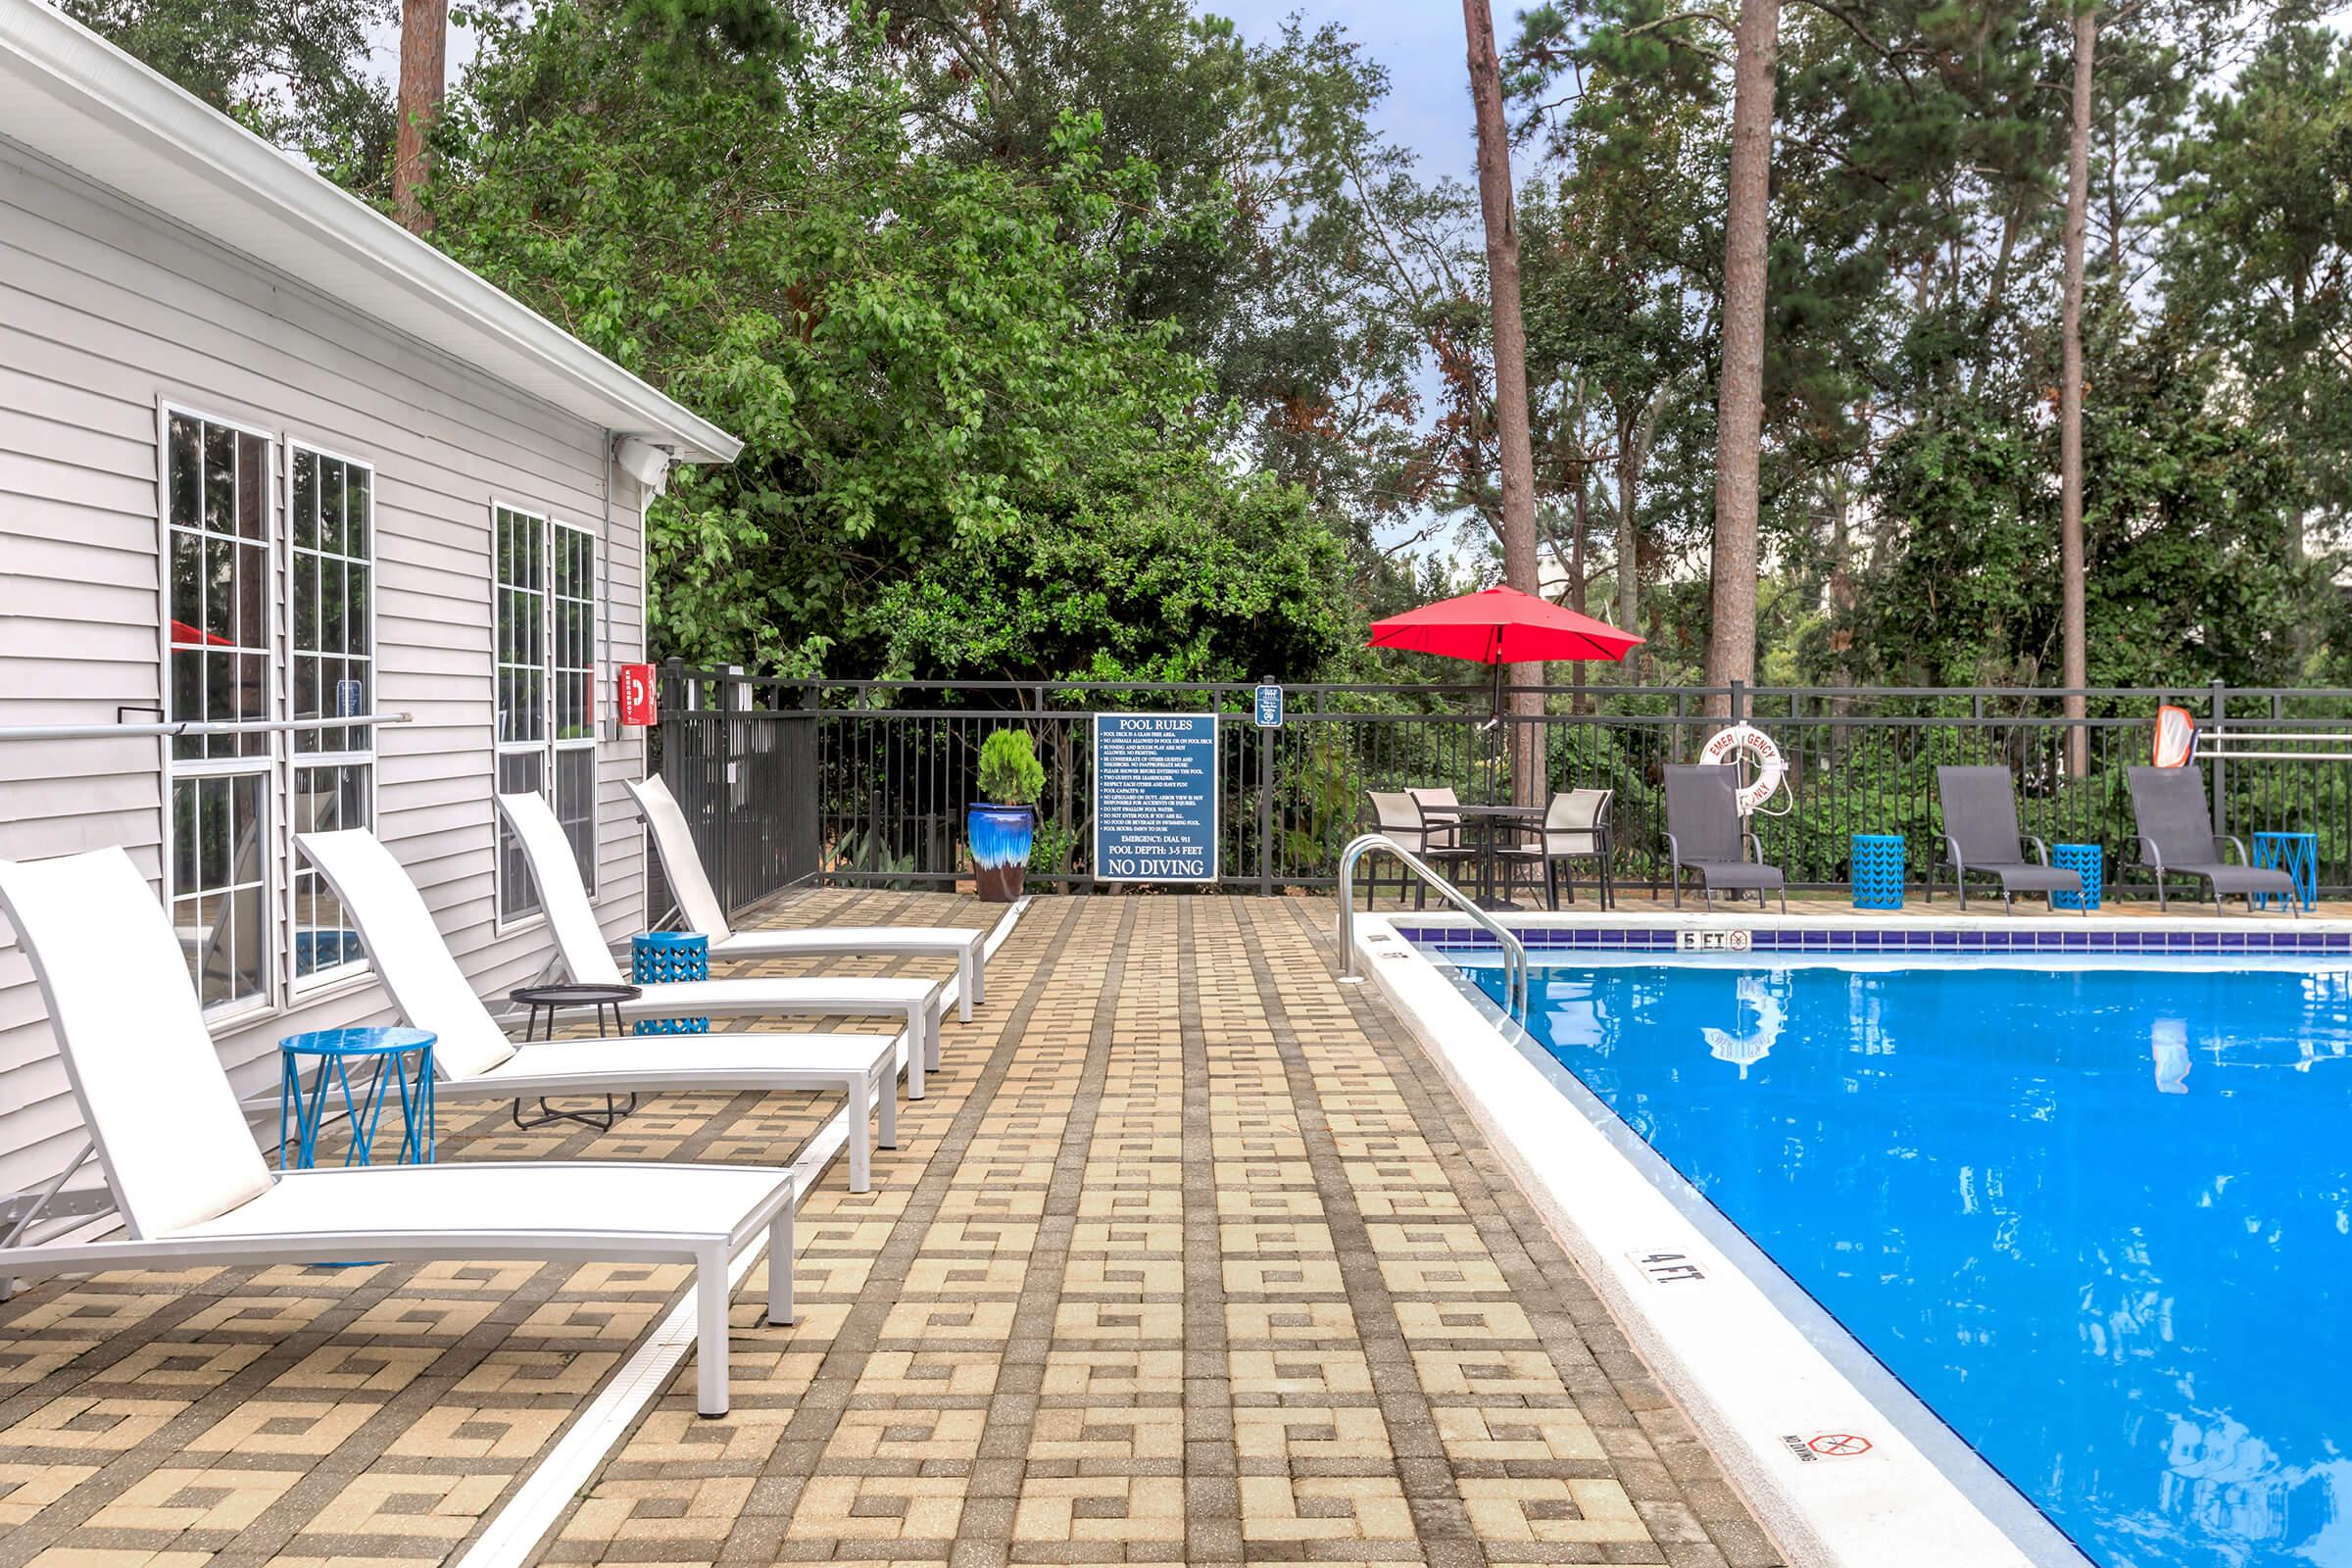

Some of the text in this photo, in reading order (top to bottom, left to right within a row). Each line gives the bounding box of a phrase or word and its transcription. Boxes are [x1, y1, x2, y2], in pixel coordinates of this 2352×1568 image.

[1120, 720, 1192, 730] POOL RULES
[1709, 733, 1775, 758] EMER GENCY
[1109, 846, 1203, 855] POOL DEPTH: 3-5 FEET
[1108, 860, 1204, 875] NO DIVING
[1684, 933, 1724, 949] 5 FT
[1641, 1254, 1686, 1264] 4
[1790, 1444, 1817, 1461] DIVING
